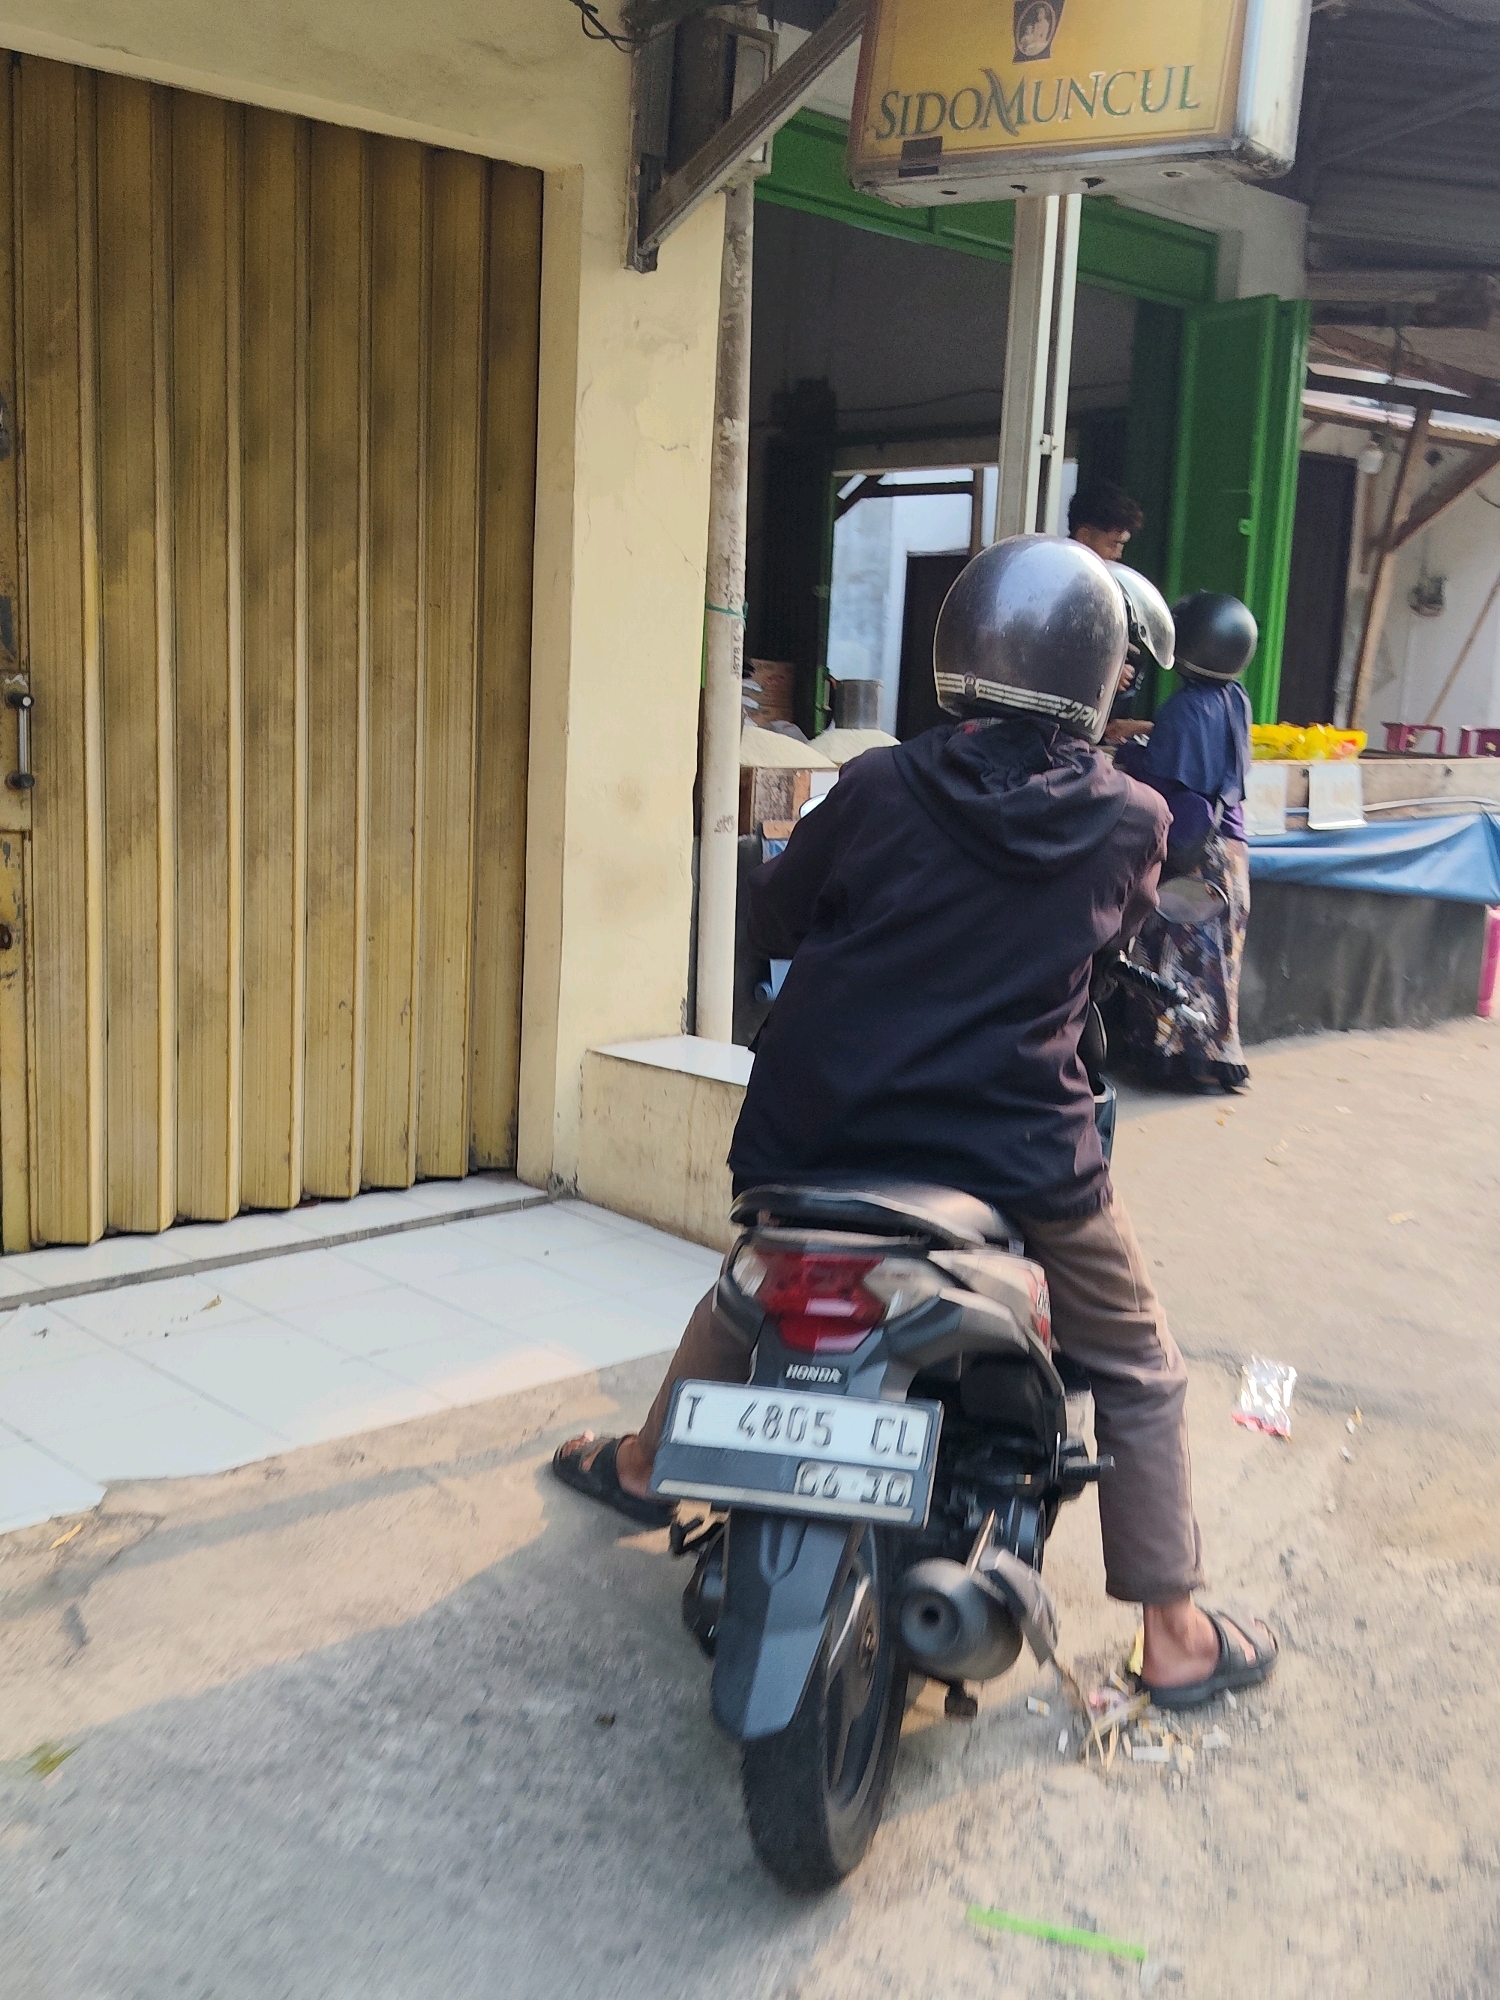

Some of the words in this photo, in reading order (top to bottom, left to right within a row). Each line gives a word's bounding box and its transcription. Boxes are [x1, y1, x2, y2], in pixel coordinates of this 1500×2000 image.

[785, 1363, 842, 1384] HONDA
[686, 1394, 704, 1430] T
[737, 1400, 836, 1449] 4805
[870, 1414, 918, 1458] CL
